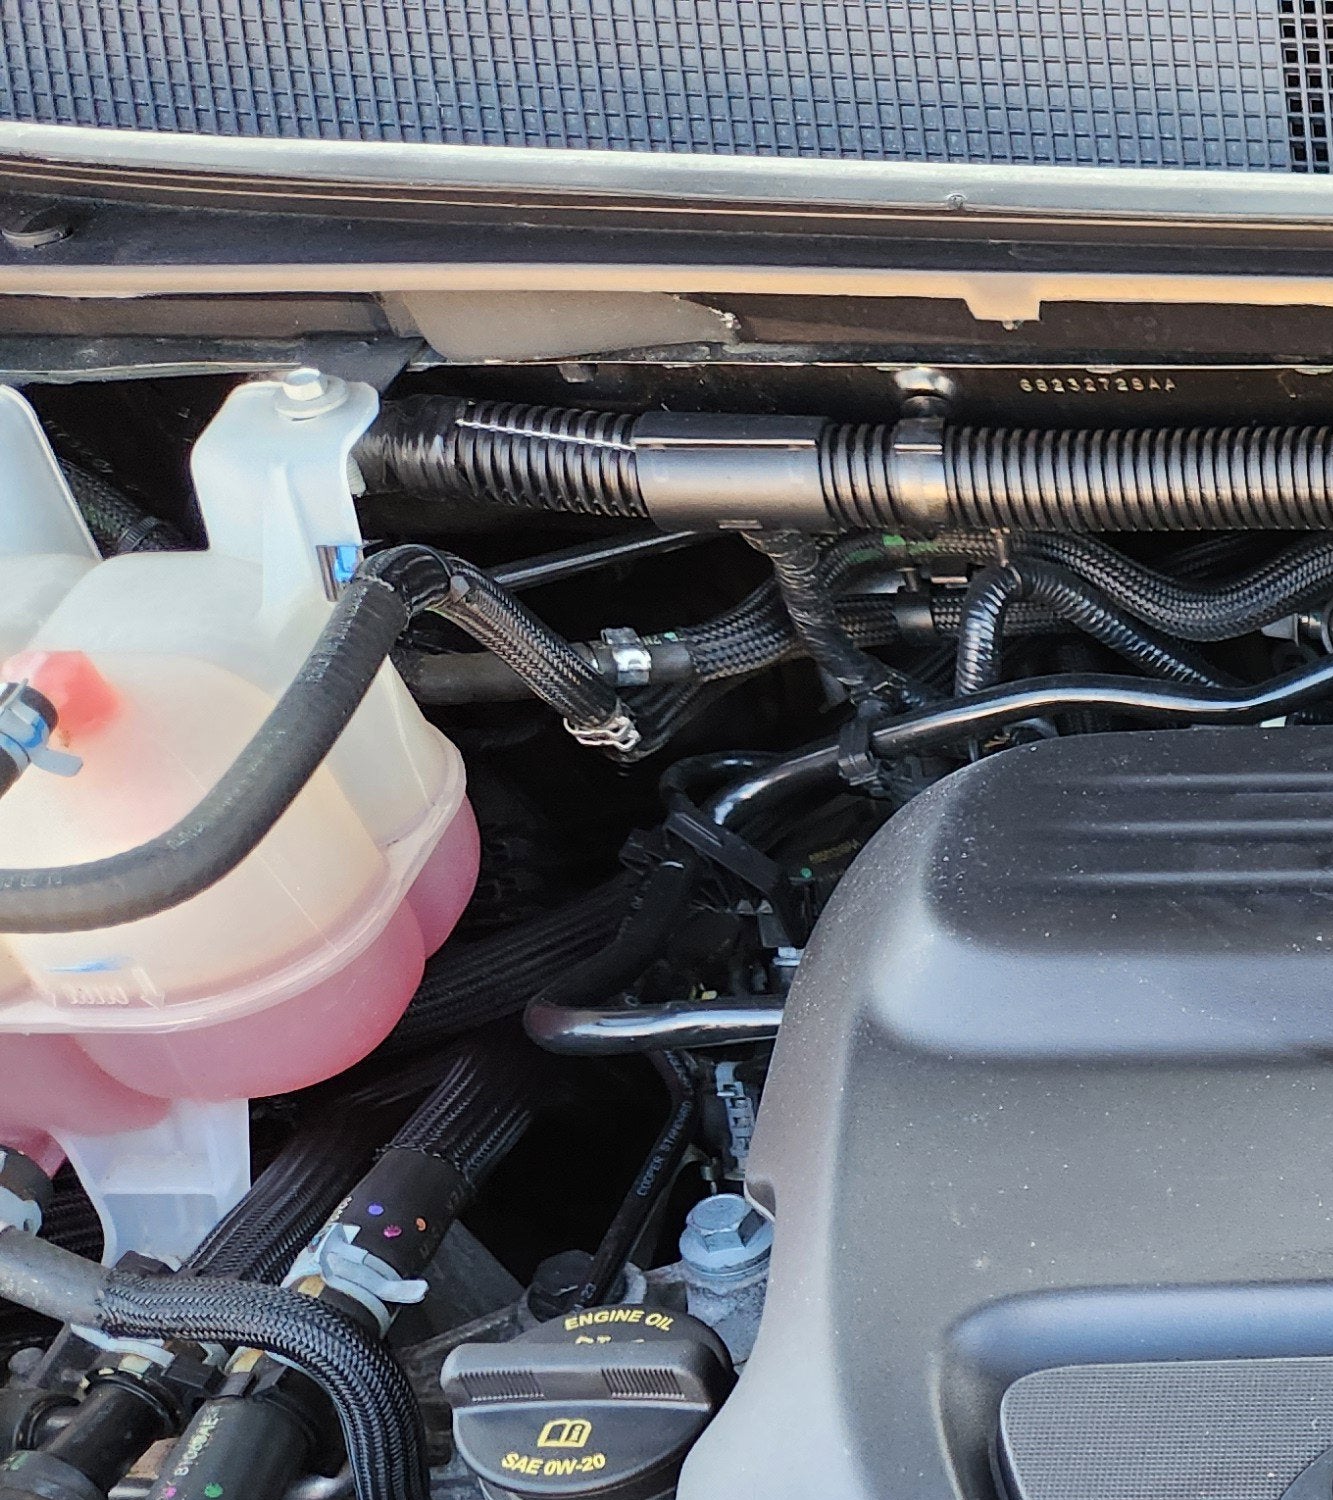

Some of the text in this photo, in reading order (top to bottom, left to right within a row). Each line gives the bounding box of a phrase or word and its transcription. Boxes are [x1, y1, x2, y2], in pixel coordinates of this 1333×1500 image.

[564, 1308, 675, 1332] ENGINE OIL
[501, 1452, 606, 1476] SAE 0W-20
